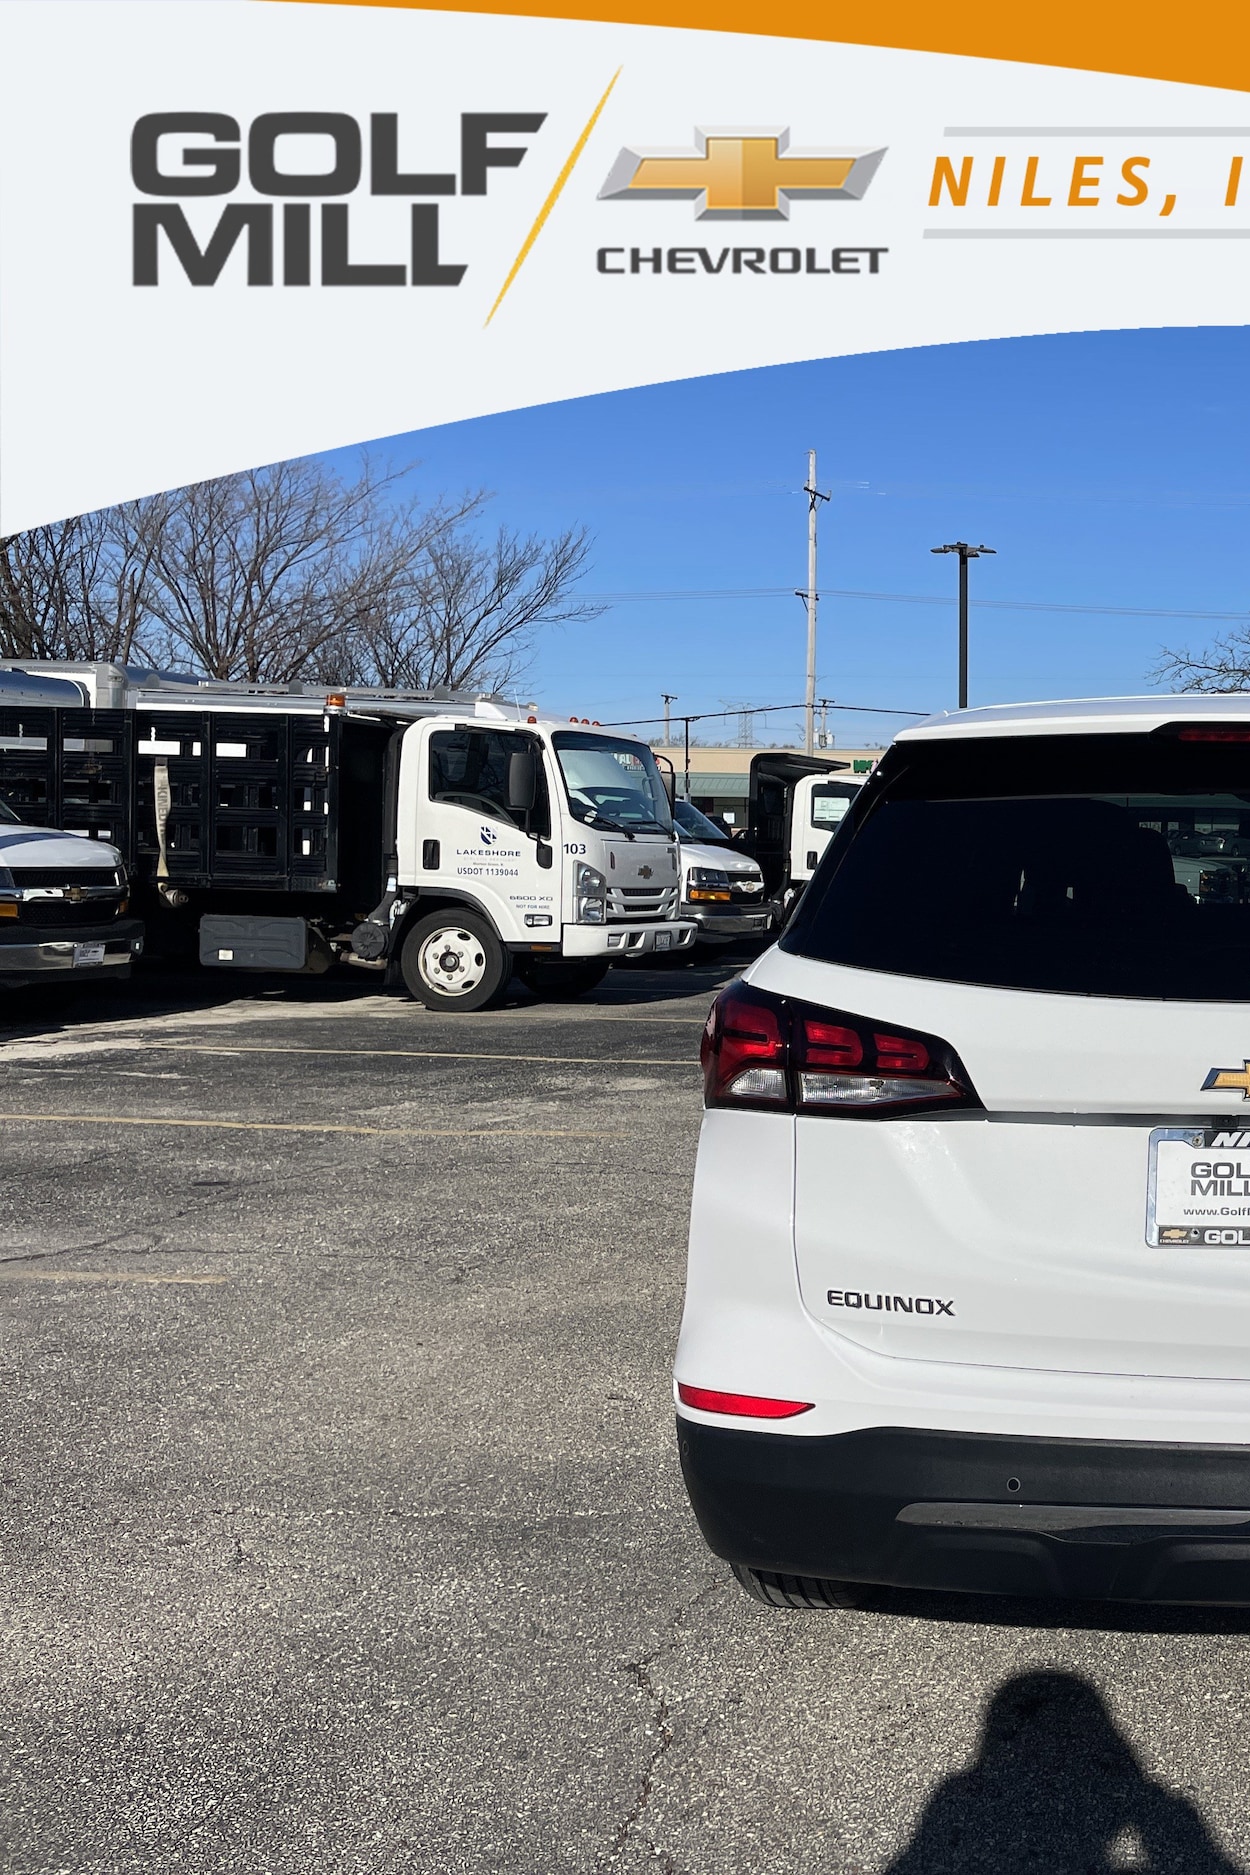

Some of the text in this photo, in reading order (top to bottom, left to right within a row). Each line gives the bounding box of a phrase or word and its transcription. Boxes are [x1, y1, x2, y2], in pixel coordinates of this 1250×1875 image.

[456, 848, 521, 857] LAKESHORE
[563, 843, 587, 855] 103
[457, 867, 519, 877] USDOT 1139044
[827, 1289, 956, 1317] EQUINOX
